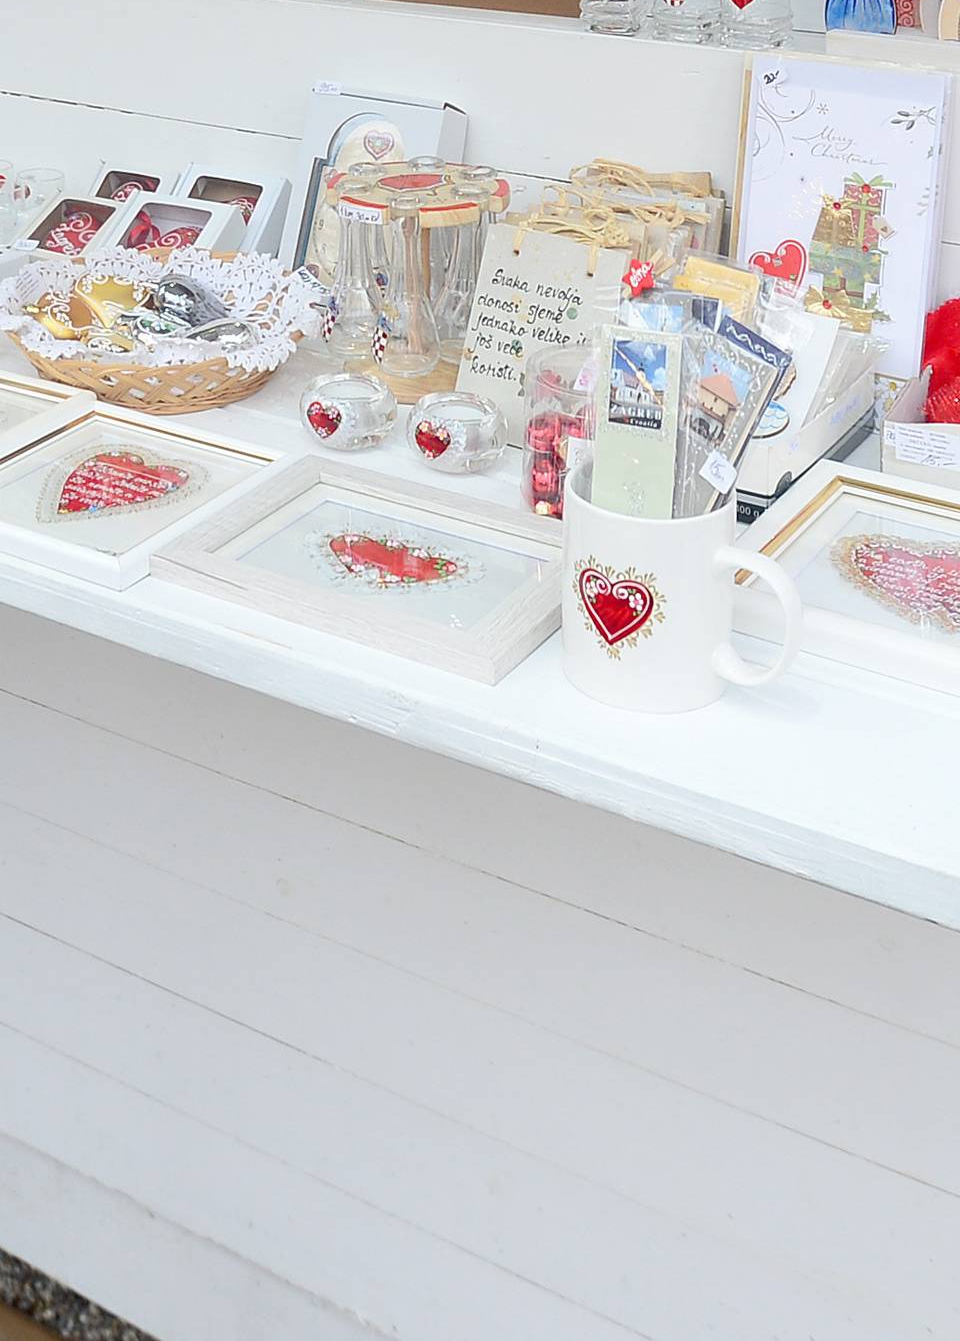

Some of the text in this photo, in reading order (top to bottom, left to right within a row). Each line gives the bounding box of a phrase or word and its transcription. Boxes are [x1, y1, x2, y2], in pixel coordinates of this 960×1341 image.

[491, 268, 530, 294] Svaka
[477, 293, 522, 313] donosi
[471, 312, 527, 337] jednako
[467, 332, 493, 354] još
[469, 354, 517, 382] koristi.
[610, 403, 663, 421] ZAGREB
